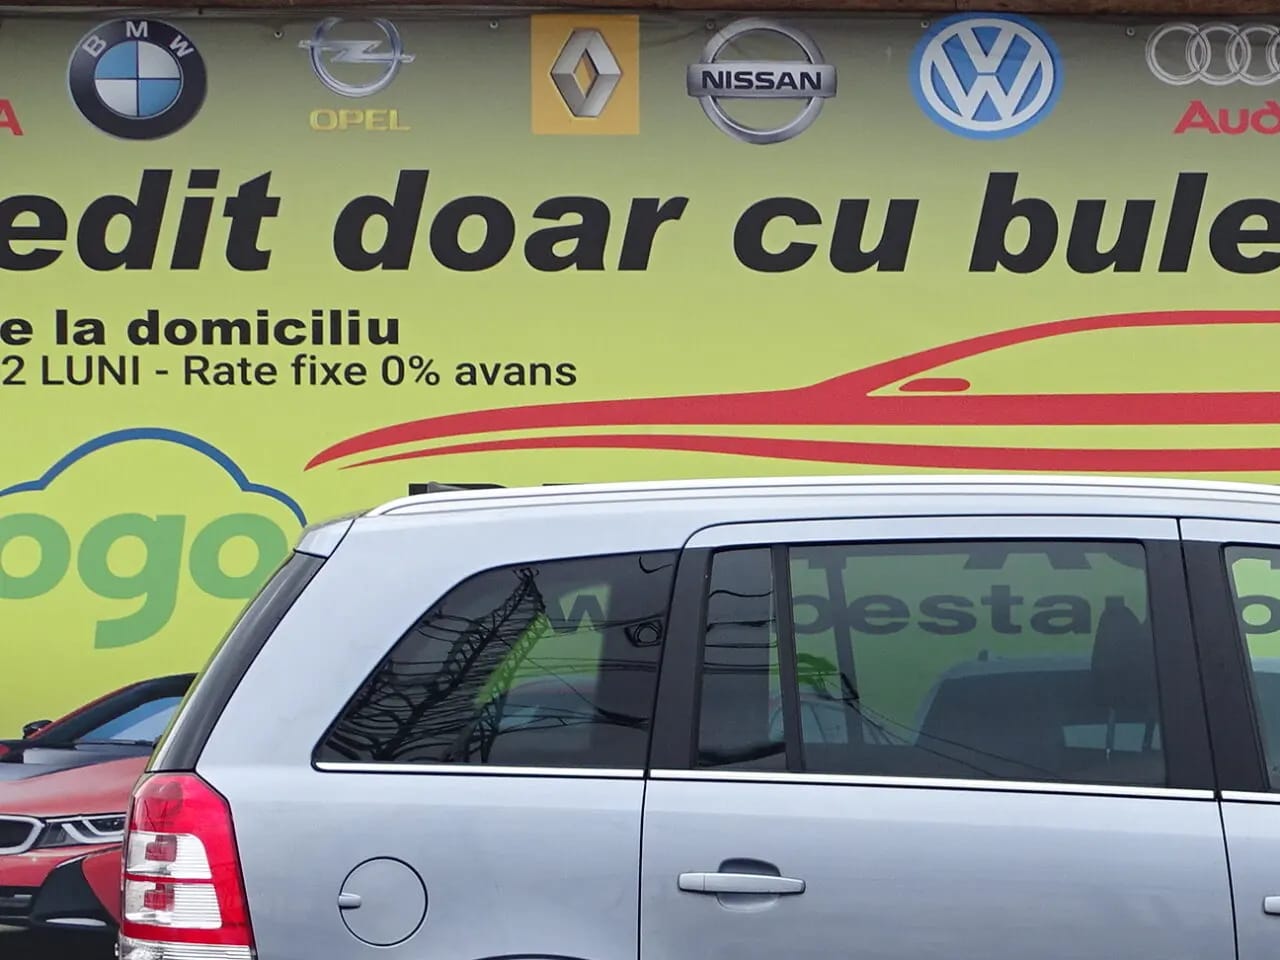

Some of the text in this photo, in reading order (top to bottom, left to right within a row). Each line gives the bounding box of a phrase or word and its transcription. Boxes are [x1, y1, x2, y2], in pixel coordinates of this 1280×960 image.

[82, 20, 194, 58] BMW
[701, 70, 822, 92] NISSAN
[310, 109, 411, 131] OPEL
[0, 169, 281, 272] edit
[333, 169, 690, 273] doar
[733, 196, 920, 274] cu
[55, 309, 106, 346] la
[127, 309, 400, 346] domiciliu
[42, 355, 140, 386] LUNI
[184, 355, 278, 386] Rate
[290, 353, 367, 386] fixe
[381, 355, 440, 386] 0%
[455, 362, 577, 386] avans
